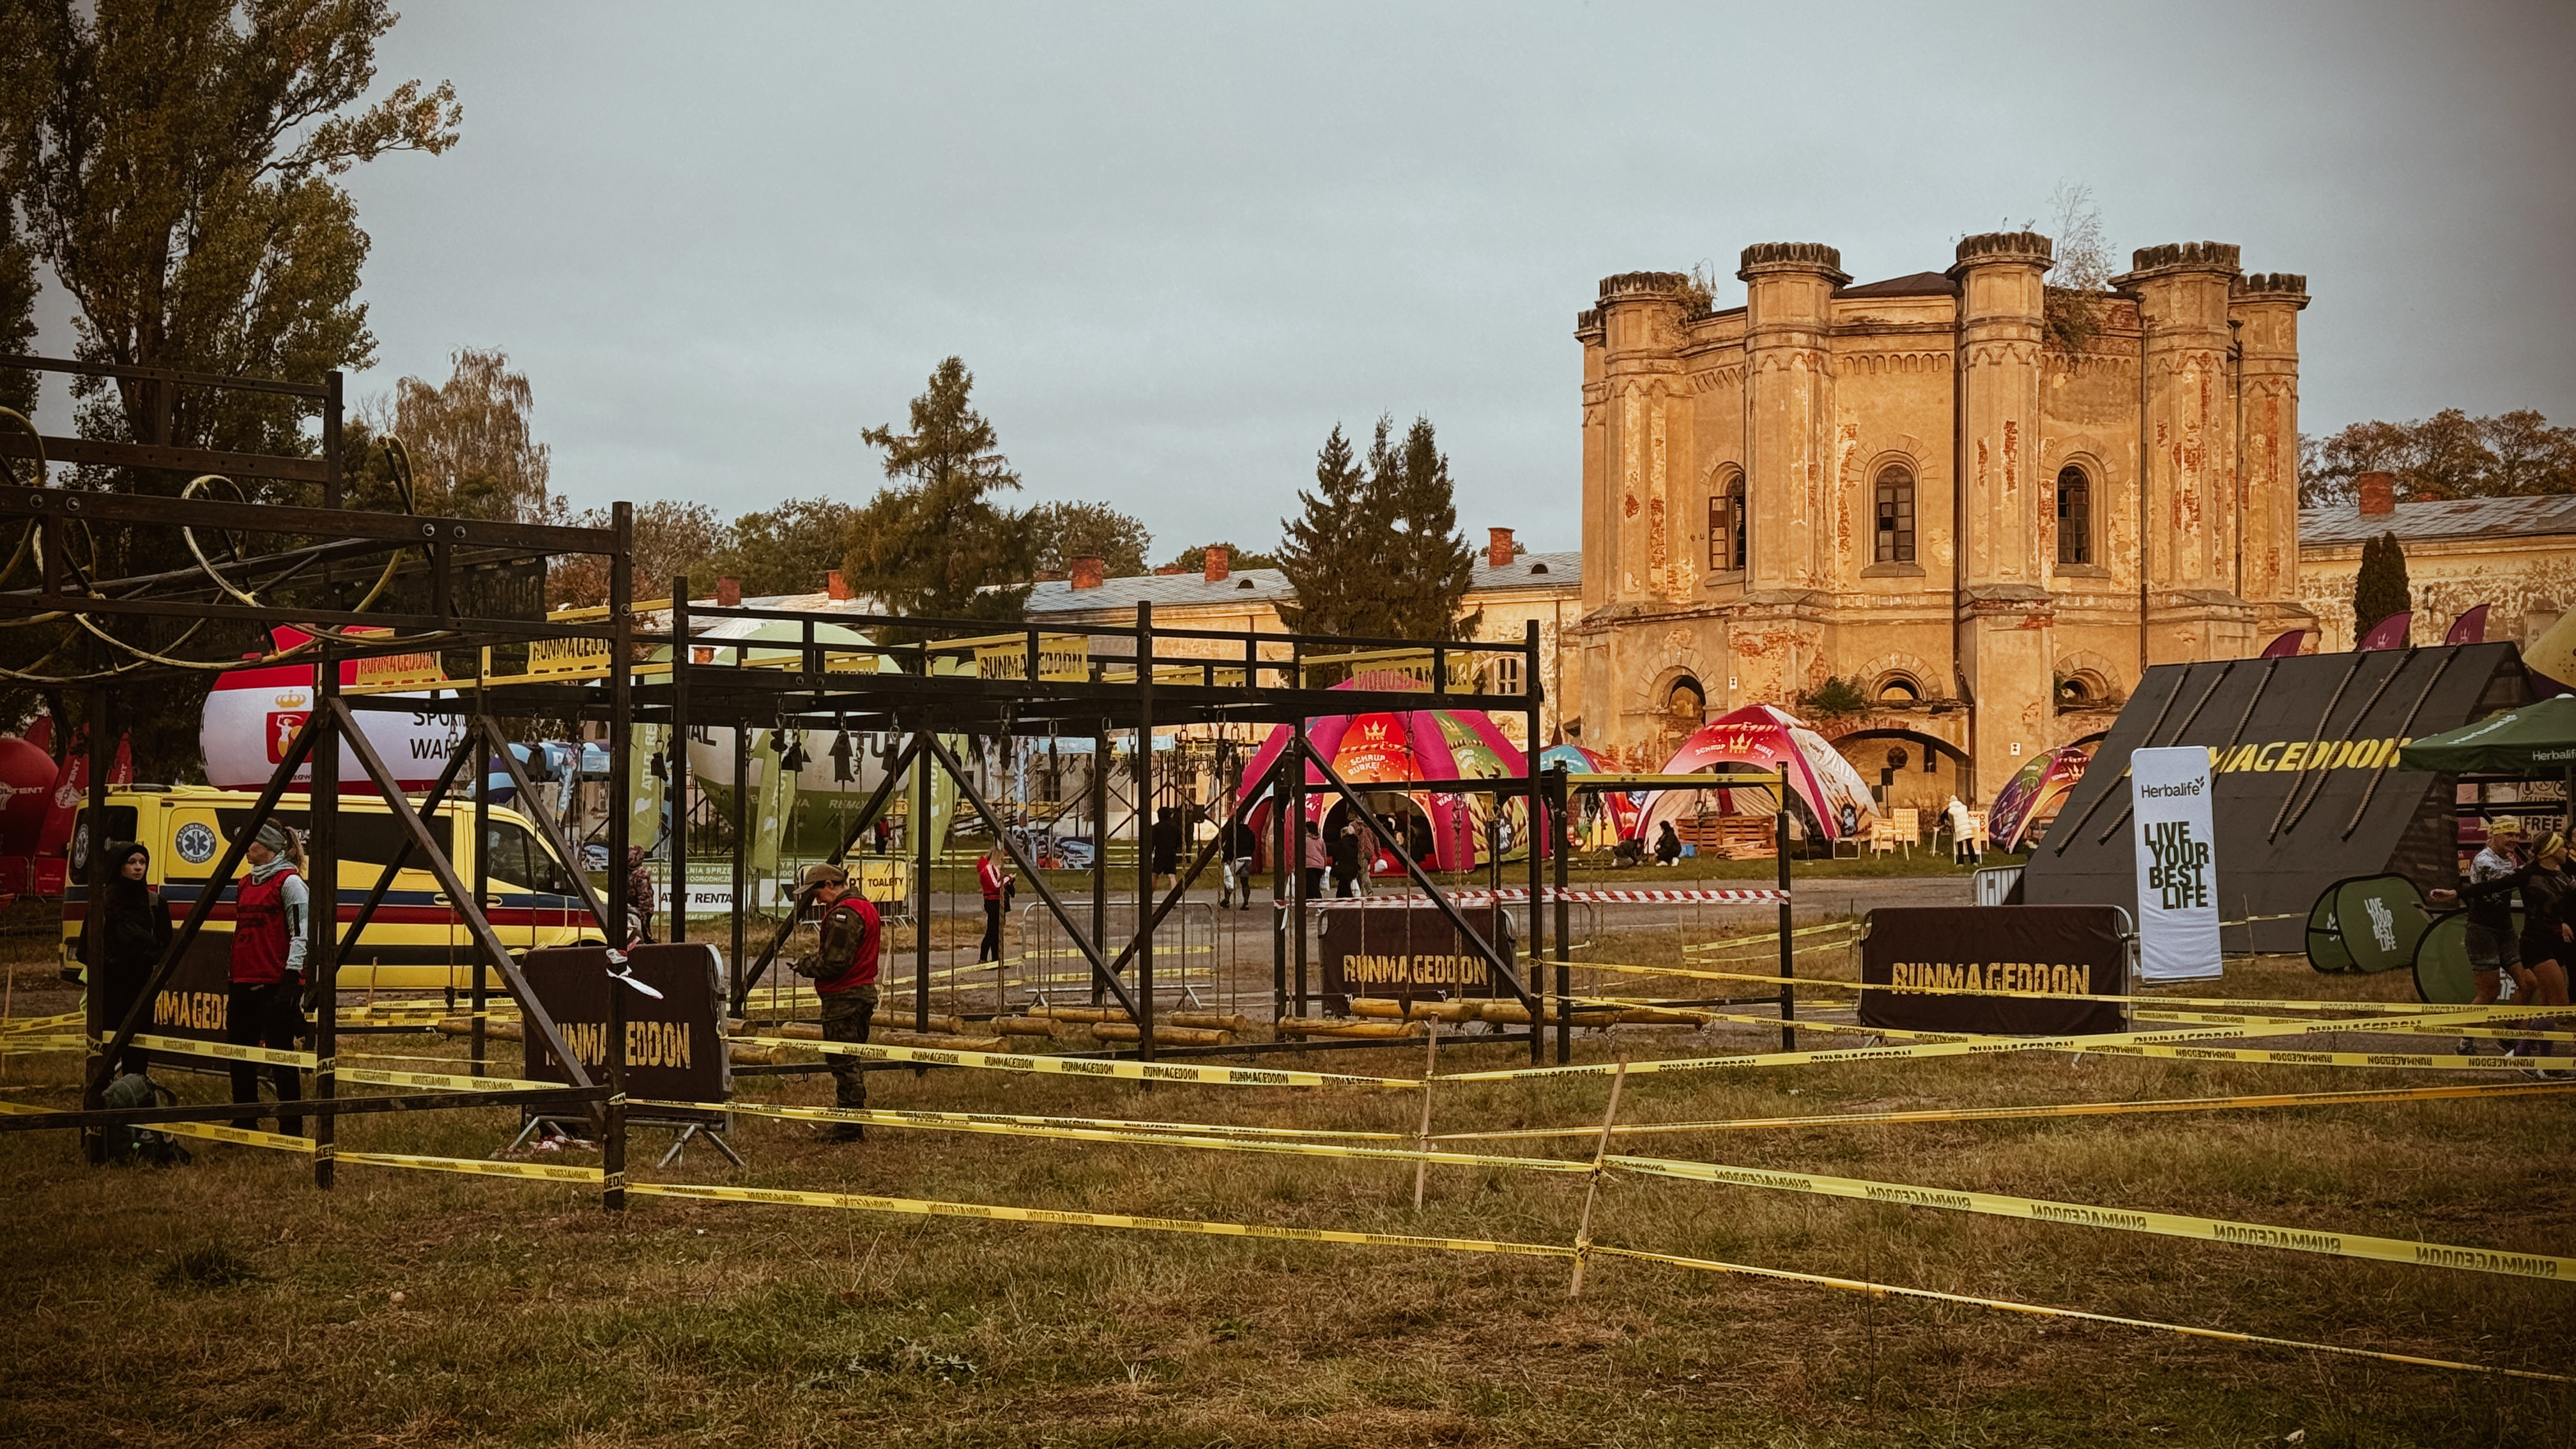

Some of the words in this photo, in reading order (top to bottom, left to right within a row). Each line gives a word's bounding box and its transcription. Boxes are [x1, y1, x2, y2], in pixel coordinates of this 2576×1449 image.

[980, 647, 1083, 679] RUNMAEDDON
[2532, 749, 2576, 761] Herbalif
[2141, 782, 2200, 799] Herbalife
[2144, 821, 2191, 847] LIVE
[2524, 817, 2563, 832] FREE
[2149, 842, 2210, 868] YOUR
[2149, 864, 2204, 889] BEST
[2163, 885, 2209, 910] LIFE
[2364, 897, 2383, 914] LIVE
[2369, 907, 2393, 926] YOUR
[2372, 924, 2393, 940] BEST
[2379, 935, 2397, 952] LIFE
[1343, 954, 1487, 986] RUNMAGEDDON
[1892, 963, 2090, 995] RUNMAGEDDON
